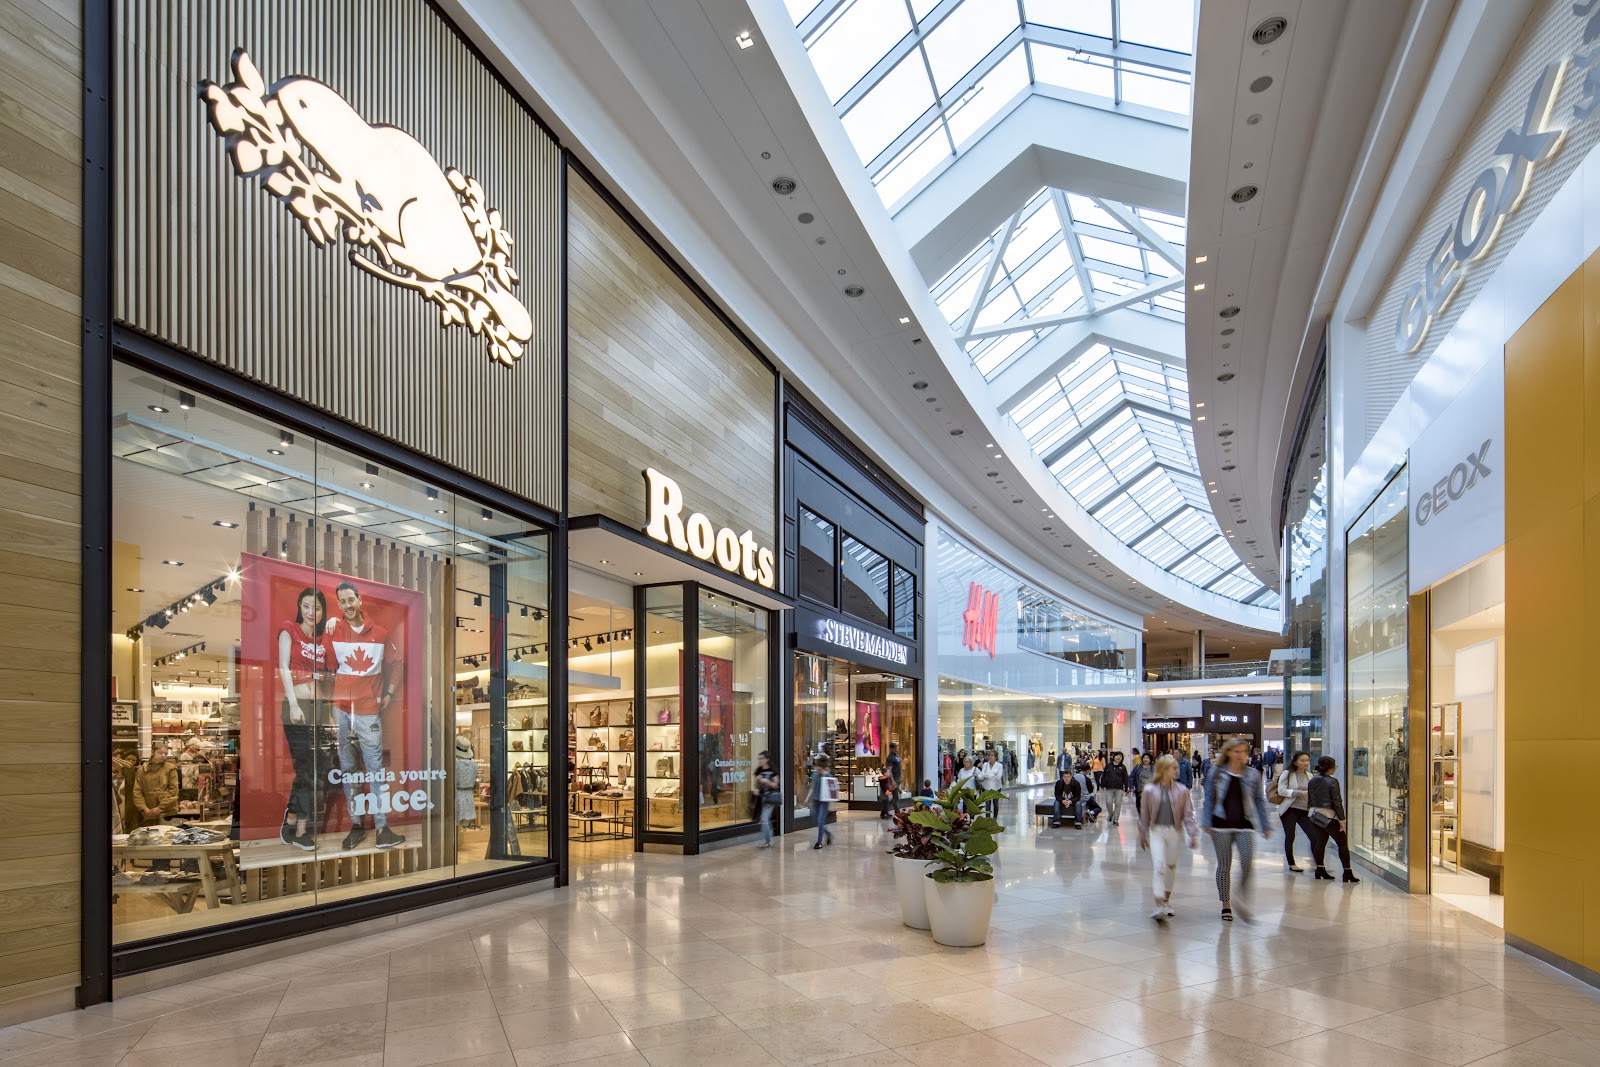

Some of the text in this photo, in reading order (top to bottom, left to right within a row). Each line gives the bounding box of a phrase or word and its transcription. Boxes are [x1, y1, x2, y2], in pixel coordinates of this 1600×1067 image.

[1395, 62, 1563, 352] GEOX
[1415, 438, 1492, 527] GEOX
[641, 467, 774, 588] Roots
[825, 618, 908, 665] STEVE MADDEN
[328, 768, 447, 784] Canada you're
[714, 758, 735, 767] Canada
[353, 784, 435, 816] nice.
